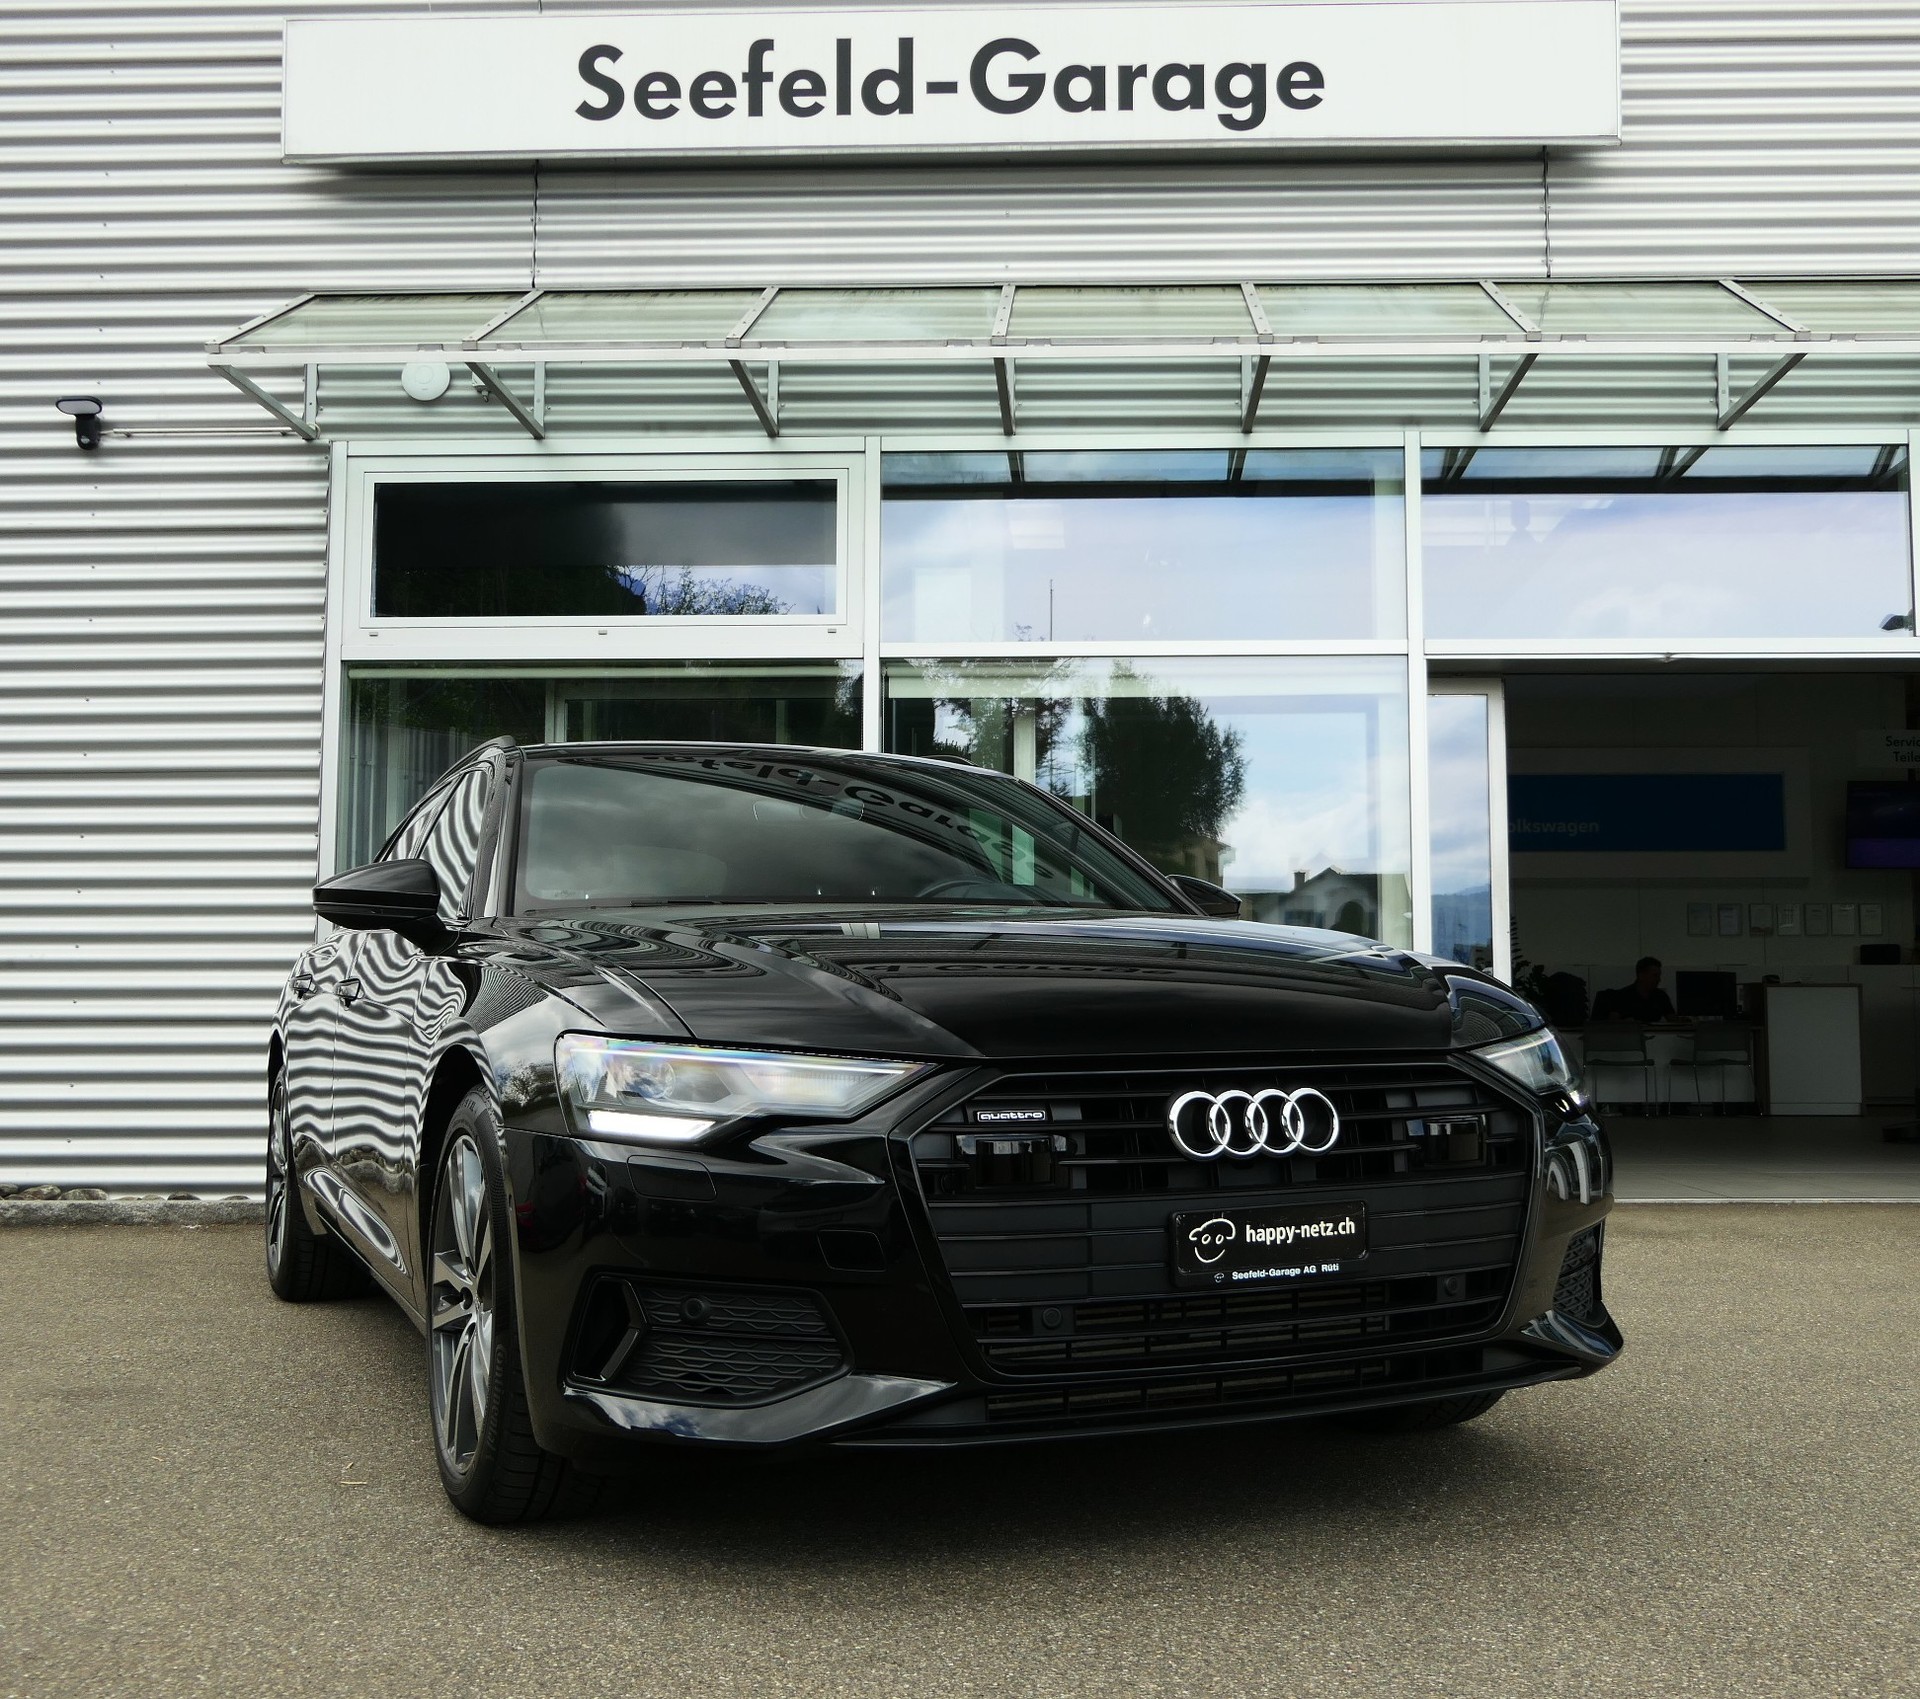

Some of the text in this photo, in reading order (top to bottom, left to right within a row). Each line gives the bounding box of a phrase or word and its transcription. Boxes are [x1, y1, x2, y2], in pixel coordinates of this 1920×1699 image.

[575, 37, 1325, 131] Seefeld-Garage
[1508, 818, 1600, 837] olkswagen
[980, 1112, 1043, 1120] quattro
[1246, 1216, 1356, 1245] happy-netz.ch
[1232, 1262, 1340, 1280] Seefeld-Garage AG Rüti
